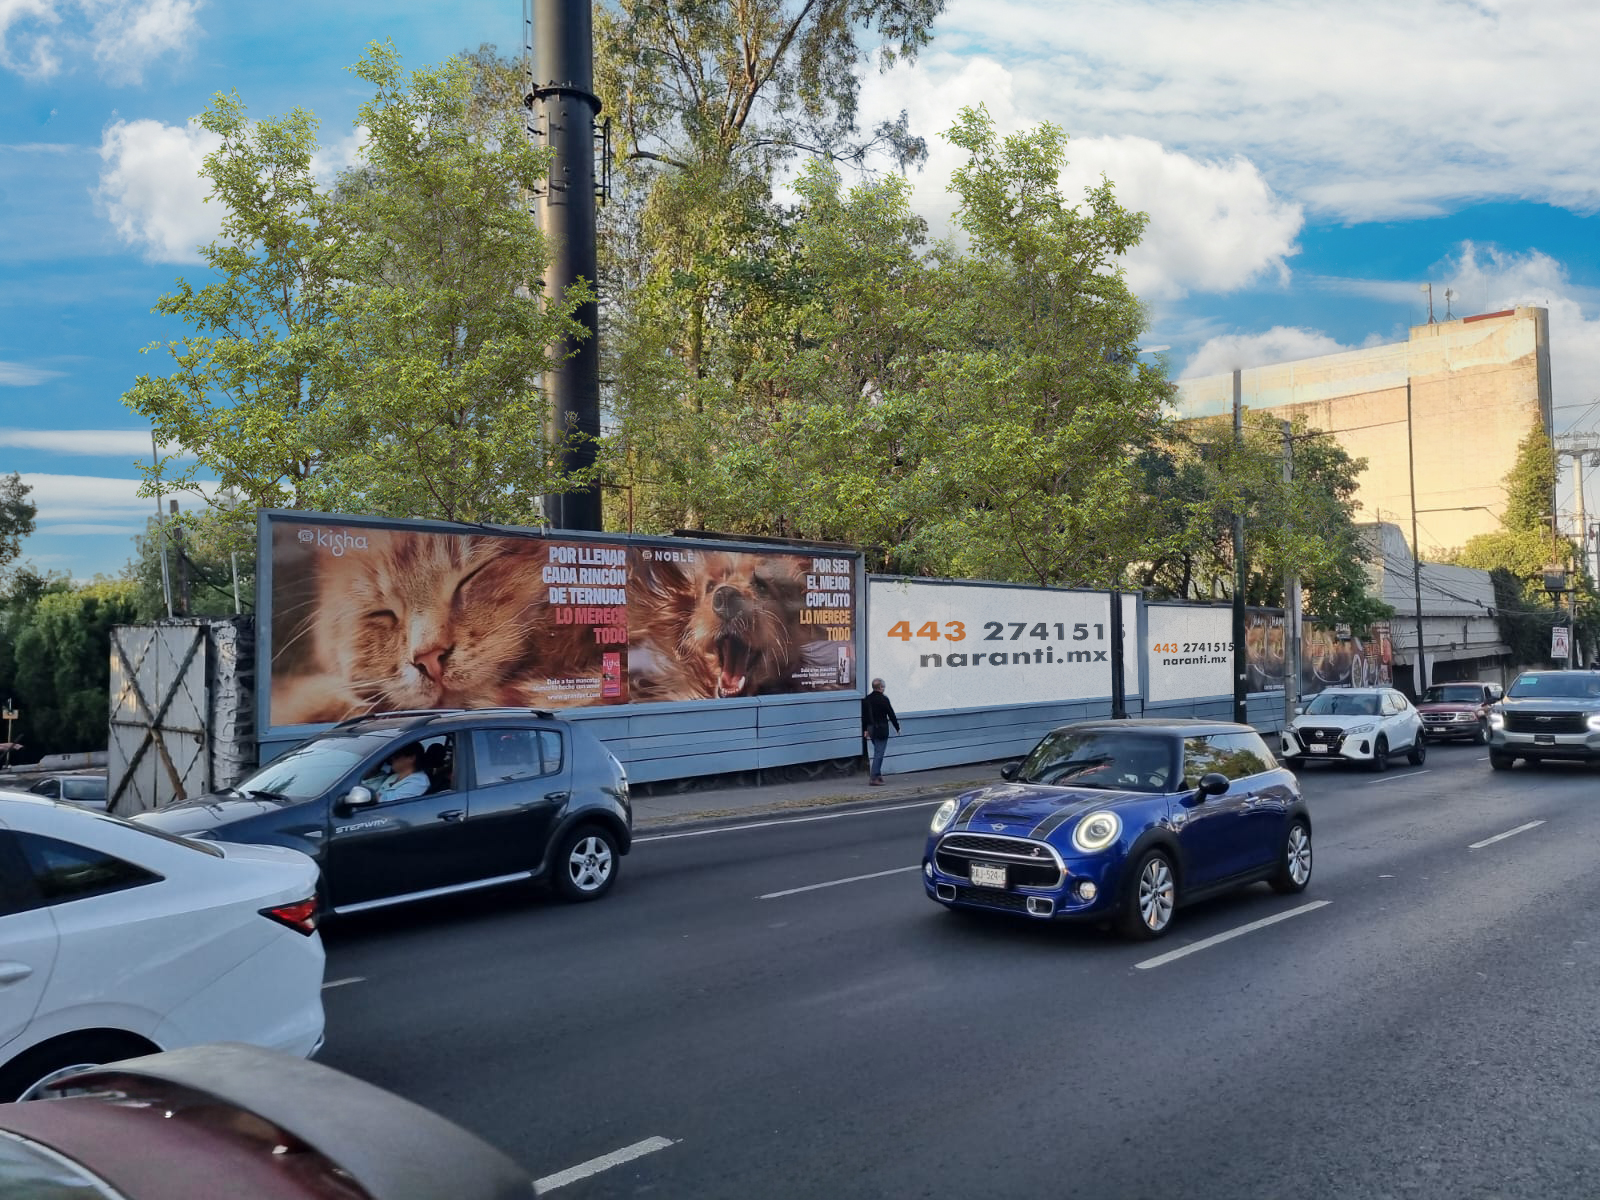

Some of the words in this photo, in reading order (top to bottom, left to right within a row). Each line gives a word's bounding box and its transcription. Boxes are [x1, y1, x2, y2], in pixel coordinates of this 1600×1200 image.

[549, 546, 576, 564] POR
[578, 547, 626, 566] LLENAR
[812, 558, 831, 572] POR
[832, 559, 850, 573] SER
[542, 566, 577, 584] CADA
[579, 564, 626, 585] RINCÓN
[806, 575, 819, 590] EL
[819, 575, 850, 591] MEJOR
[549, 587, 567, 604] DE
[568, 587, 627, 605] TERNURA
[805, 592, 850, 607] COPILOTO
[555, 608, 572, 625] LO
[574, 608, 627, 625] MERECE
[800, 609, 813, 625] LO
[813, 609, 851, 625] MERECE
[593, 628, 627, 644] TODO
[826, 627, 851, 641] TODO
[887, 620, 967, 642] 443
[983, 621, 1126, 641] 274151
[1153, 643, 1178, 654] 443
[1183, 642, 1235, 653] 2741515
[920, 646, 1108, 668] naranti.mx
[1163, 654, 1227, 666] naranti.mx
